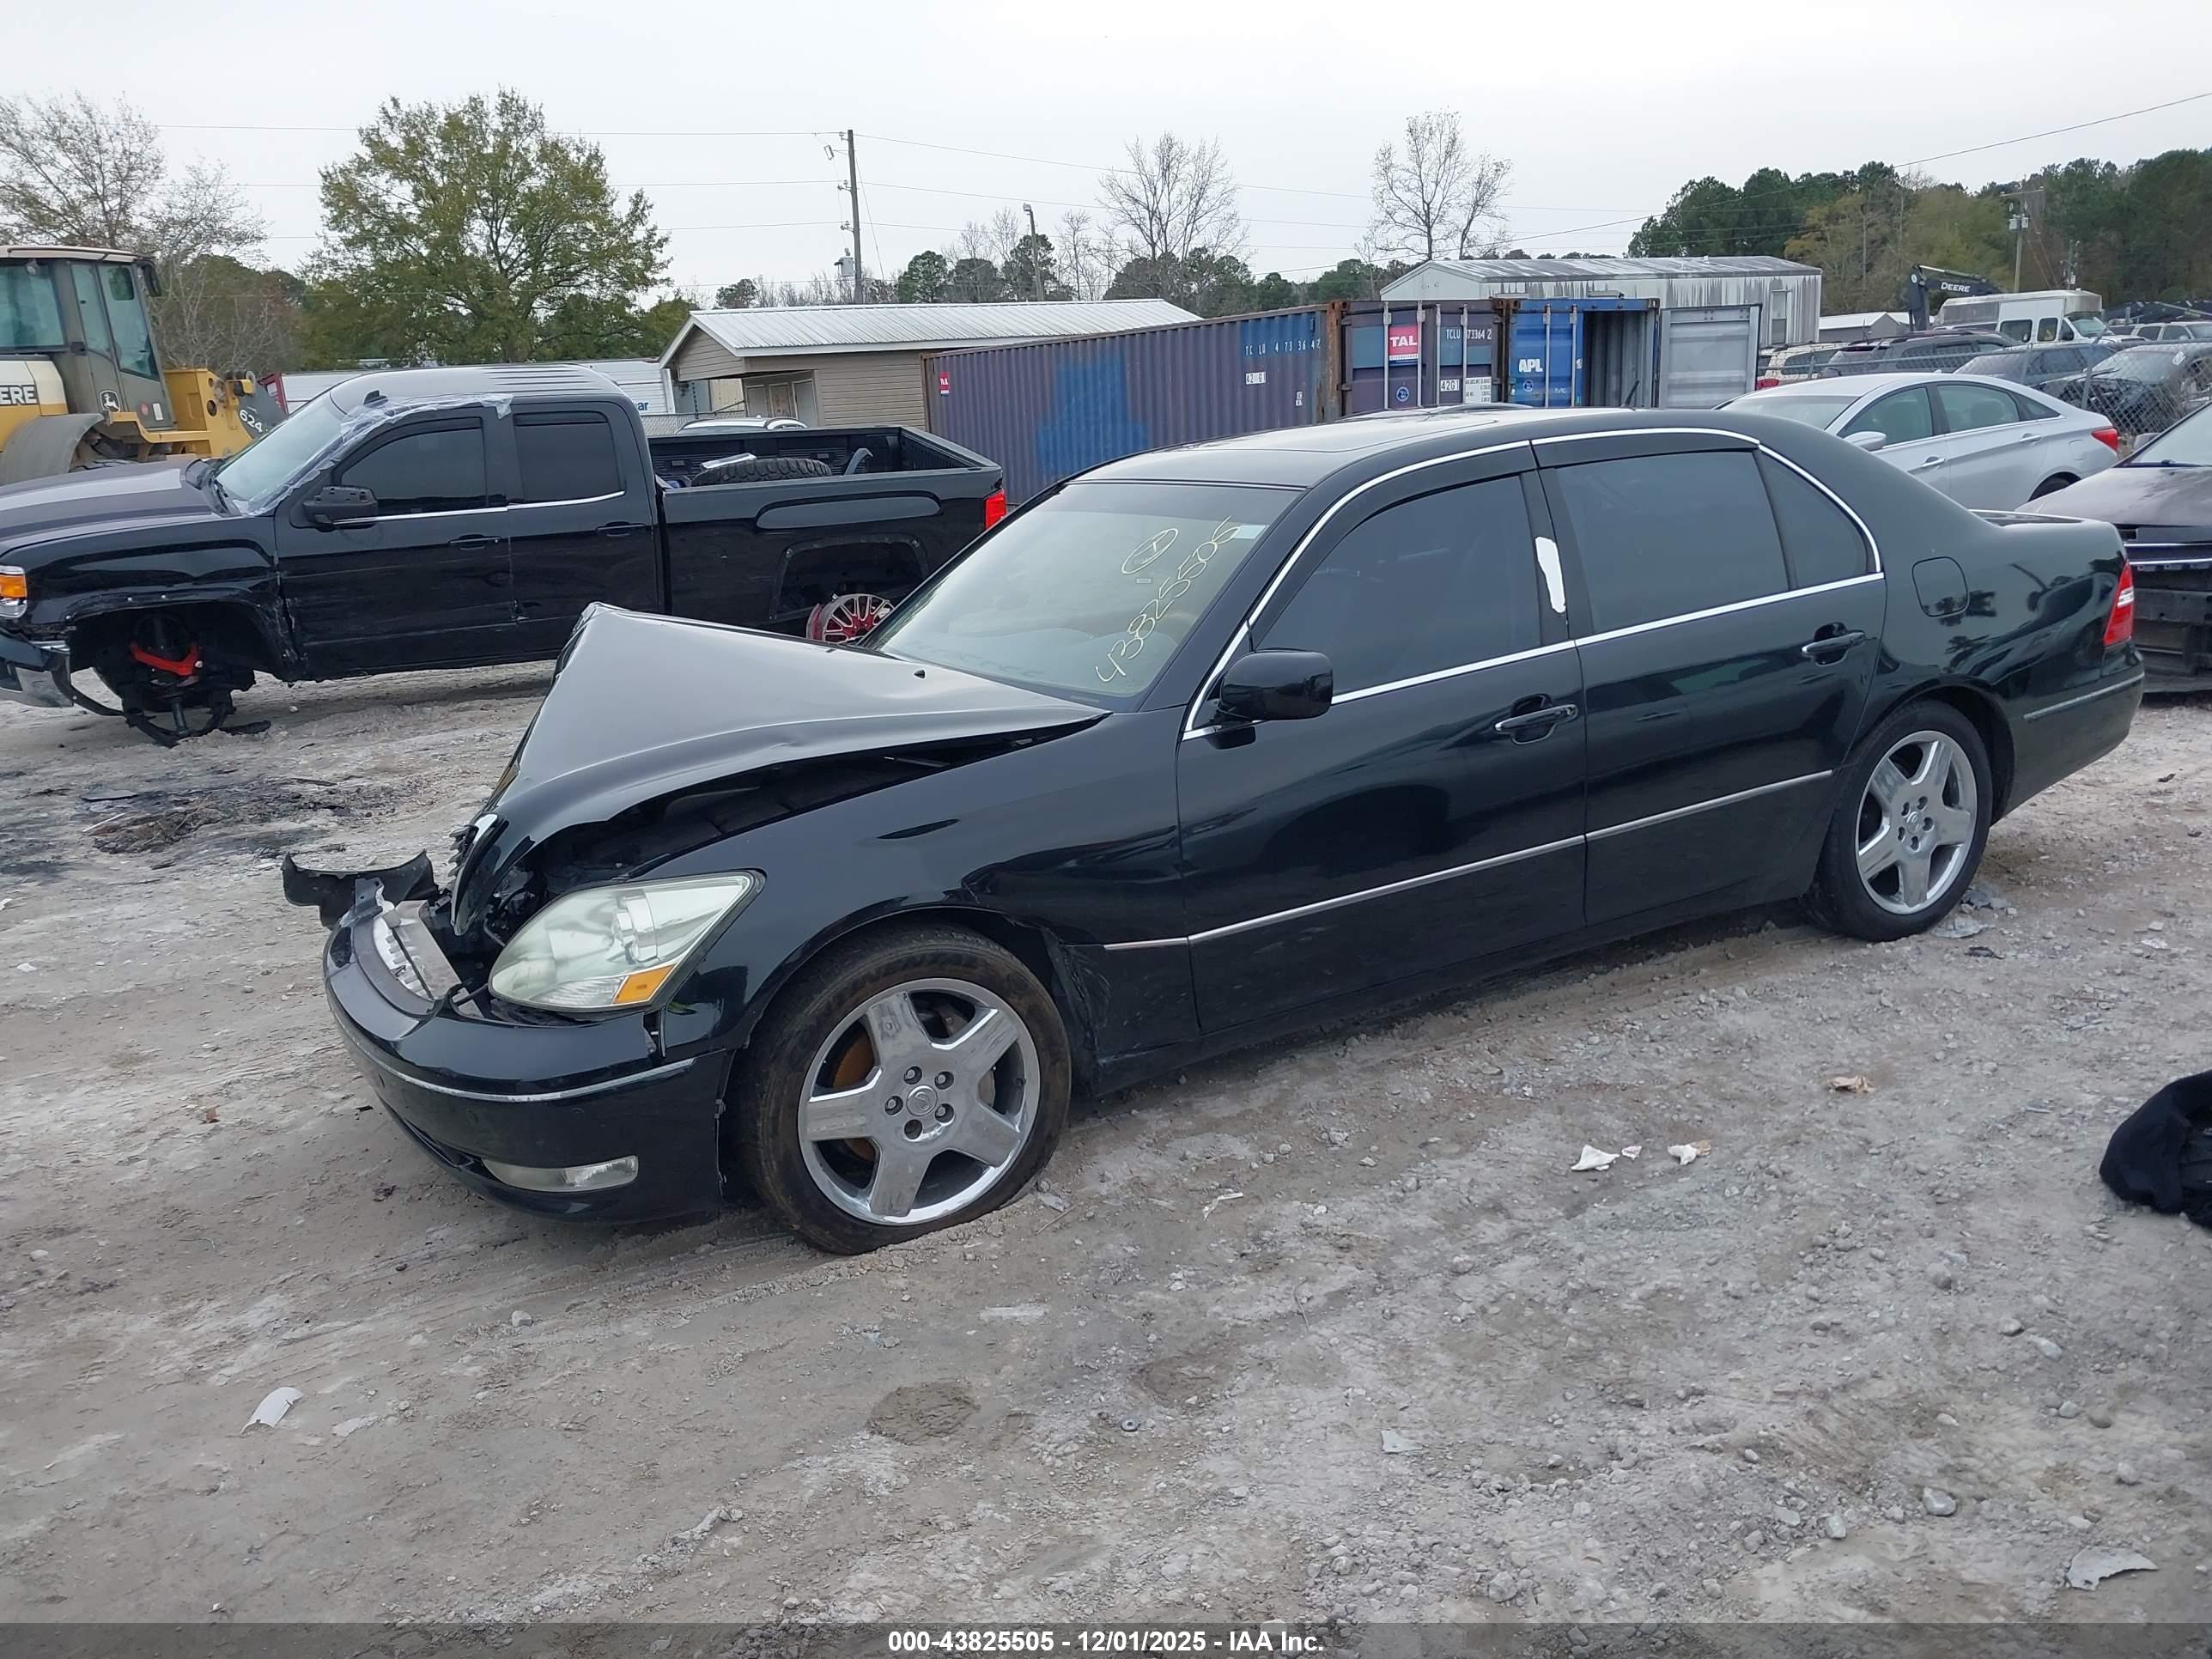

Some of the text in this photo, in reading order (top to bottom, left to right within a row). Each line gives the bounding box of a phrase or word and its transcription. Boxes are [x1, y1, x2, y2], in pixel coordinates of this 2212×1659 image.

[1941, 282, 1971, 293] DEERE
[1446, 328, 1461, 339] TCLU
[1465, 329, 1486, 340] 73364
[1390, 336, 1418, 347] TAL
[1518, 358, 1543, 373] APL
[1440, 380, 1460, 392] 42G1
